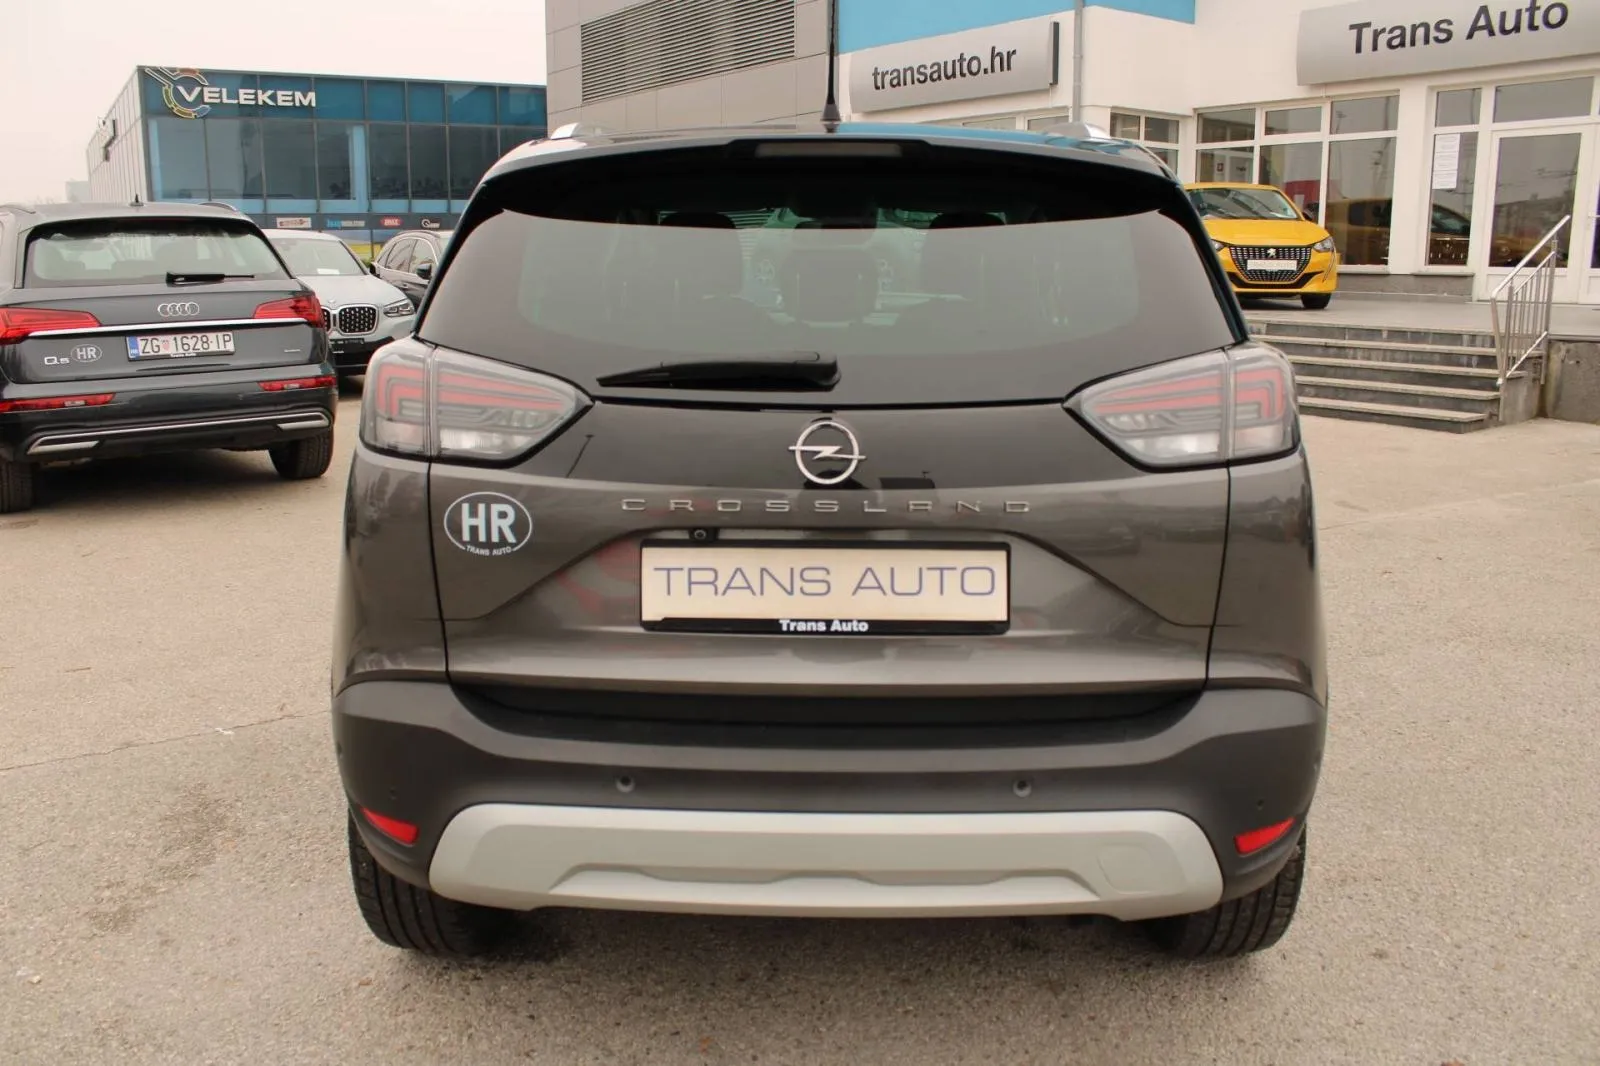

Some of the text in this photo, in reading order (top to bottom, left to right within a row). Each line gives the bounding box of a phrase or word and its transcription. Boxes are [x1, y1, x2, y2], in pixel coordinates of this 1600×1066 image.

[1349, 0, 1569, 54] Trans Auto
[872, 46, 1017, 91] transauto.hr
[176, 85, 316, 107] VELEKEM
[76, 346, 97, 360] HR
[140, 338, 160, 354] ZG
[621, 499, 1031, 513] CROSSLAND
[461, 503, 517, 543] HR
[466, 545, 512, 556] TRANS AUTO
[653, 567, 996, 597] TRANS AUTO
[779, 619, 869, 632] Trans Auto
